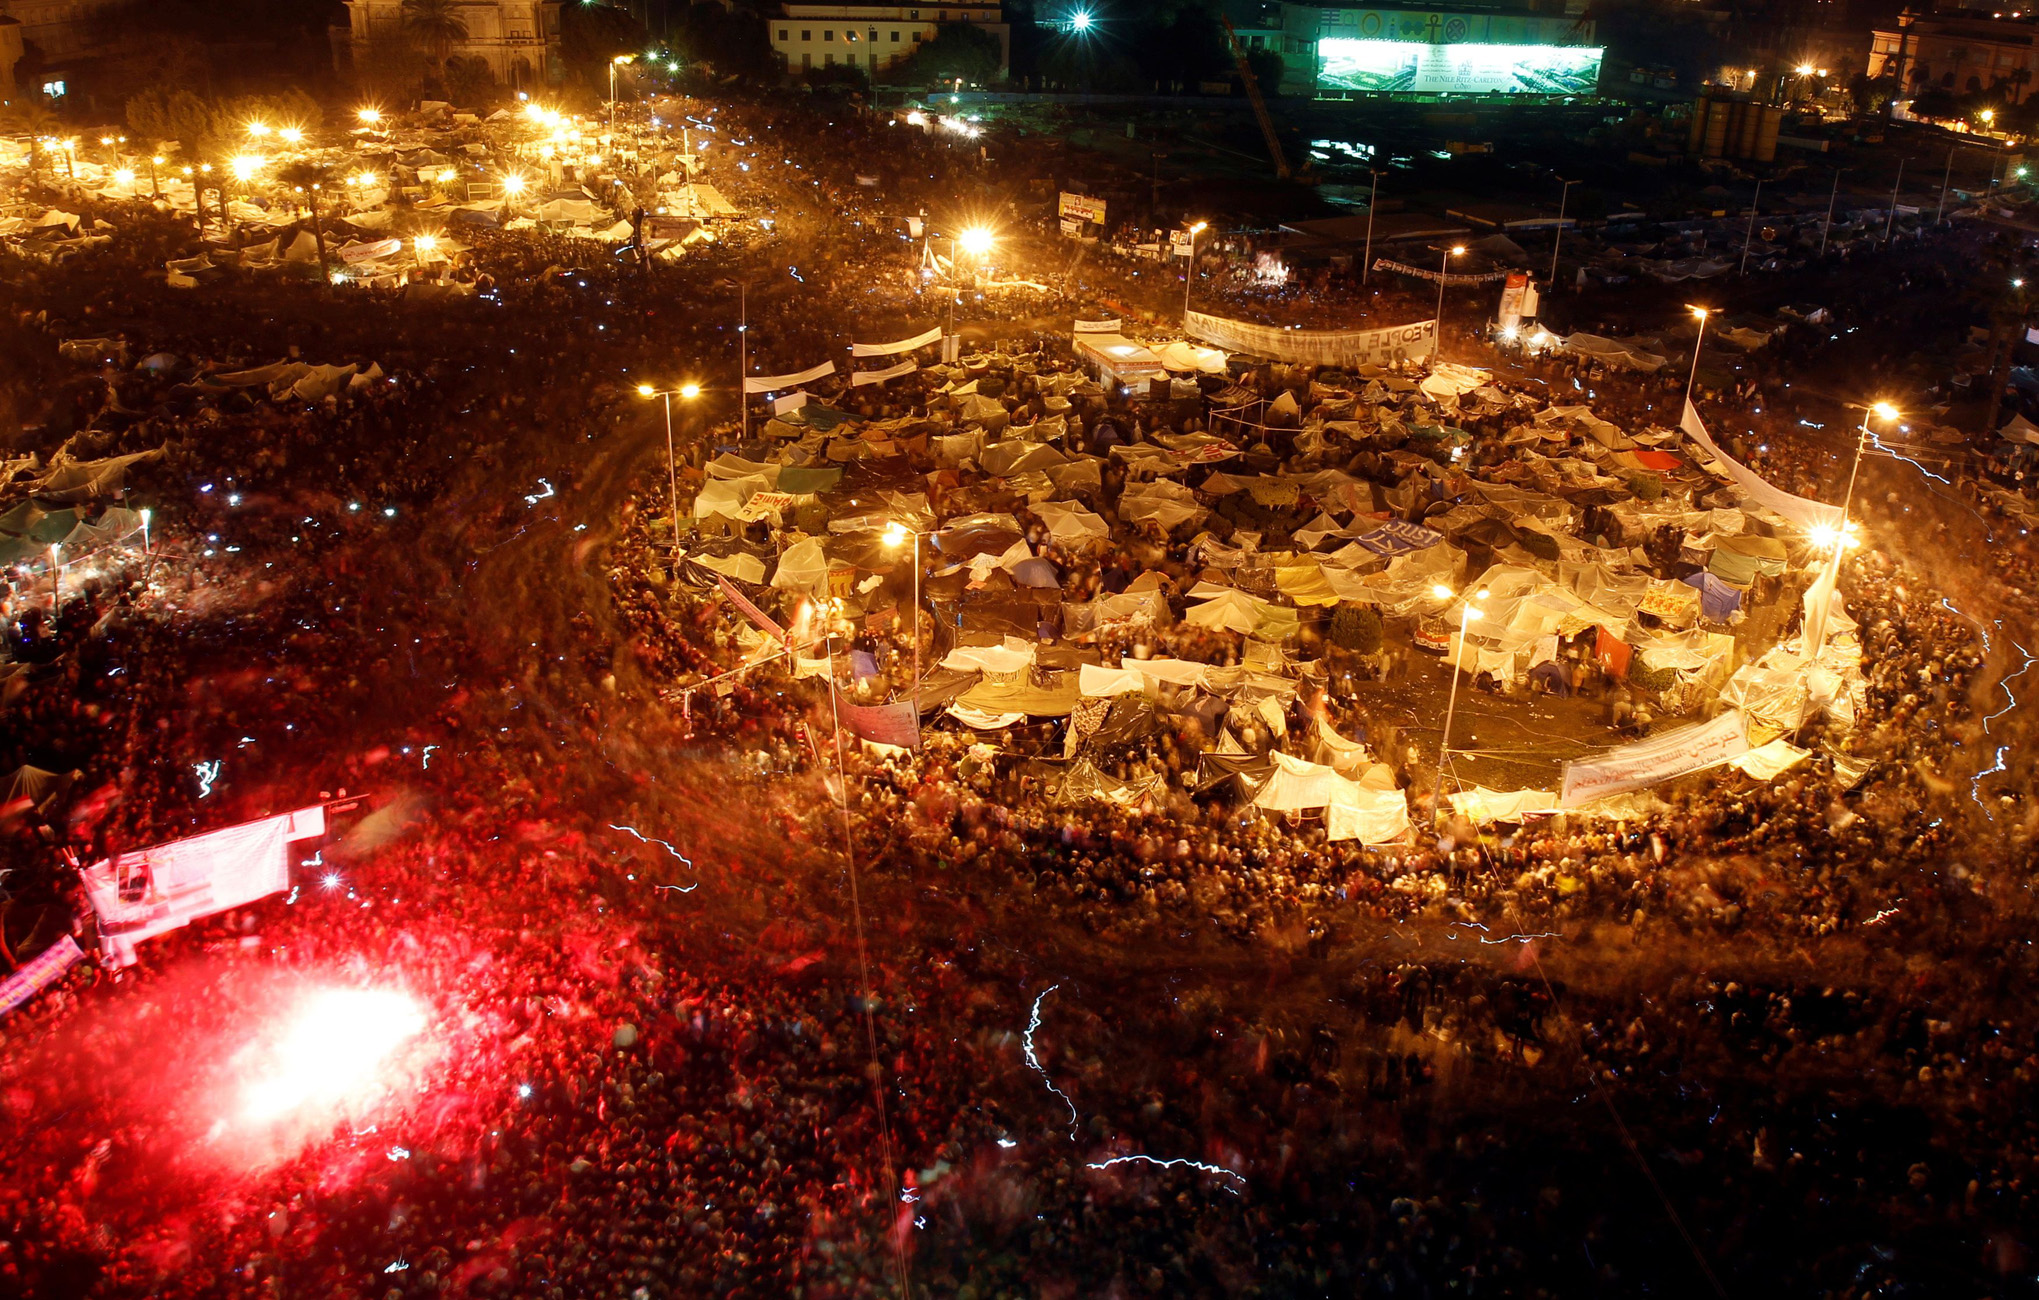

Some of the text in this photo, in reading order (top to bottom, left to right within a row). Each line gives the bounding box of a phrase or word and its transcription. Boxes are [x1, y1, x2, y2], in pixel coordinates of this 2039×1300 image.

[1424, 75, 1438, 83] THE
[1439, 75, 1454, 83] NILE
[1386, 521, 1442, 544] JUST
